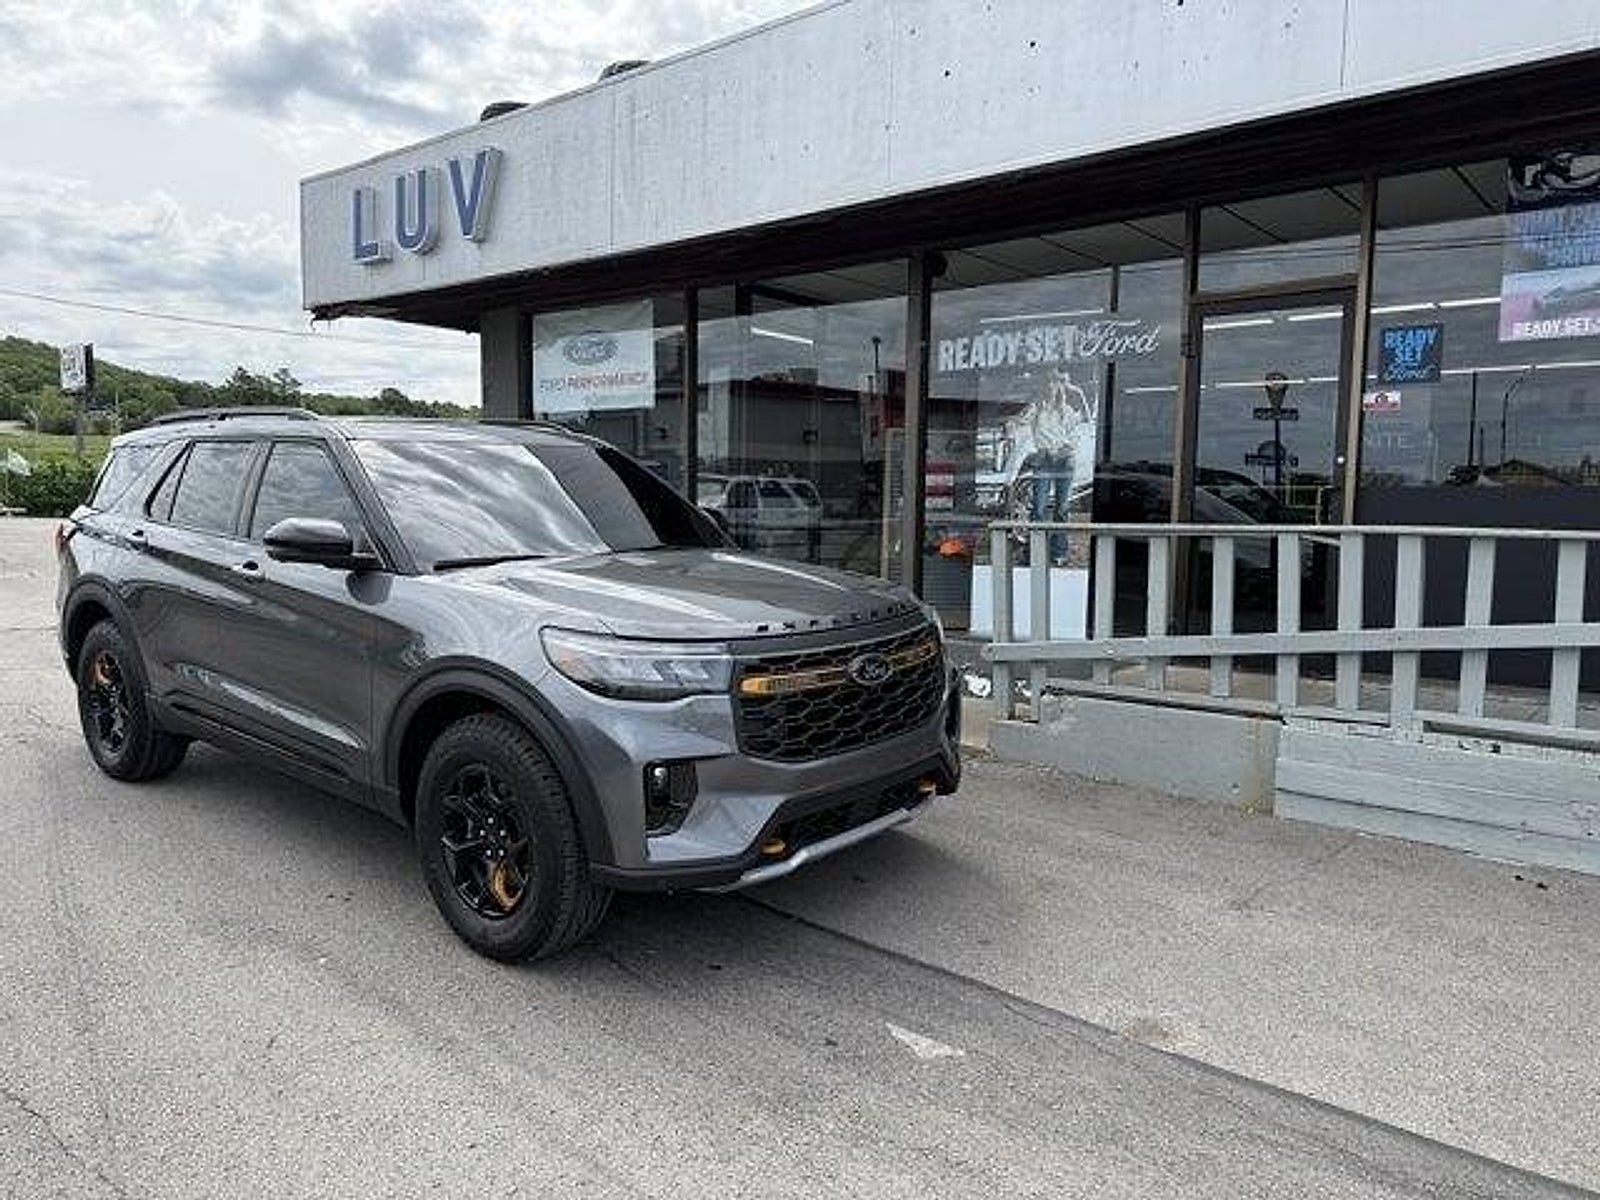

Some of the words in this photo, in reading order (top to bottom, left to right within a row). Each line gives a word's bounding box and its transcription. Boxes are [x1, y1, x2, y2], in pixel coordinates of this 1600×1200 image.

[352, 149, 500, 262] LUV
[1080, 320, 1160, 357] Ford
[1385, 328, 1437, 348] READY
[1395, 347, 1422, 362] SET
